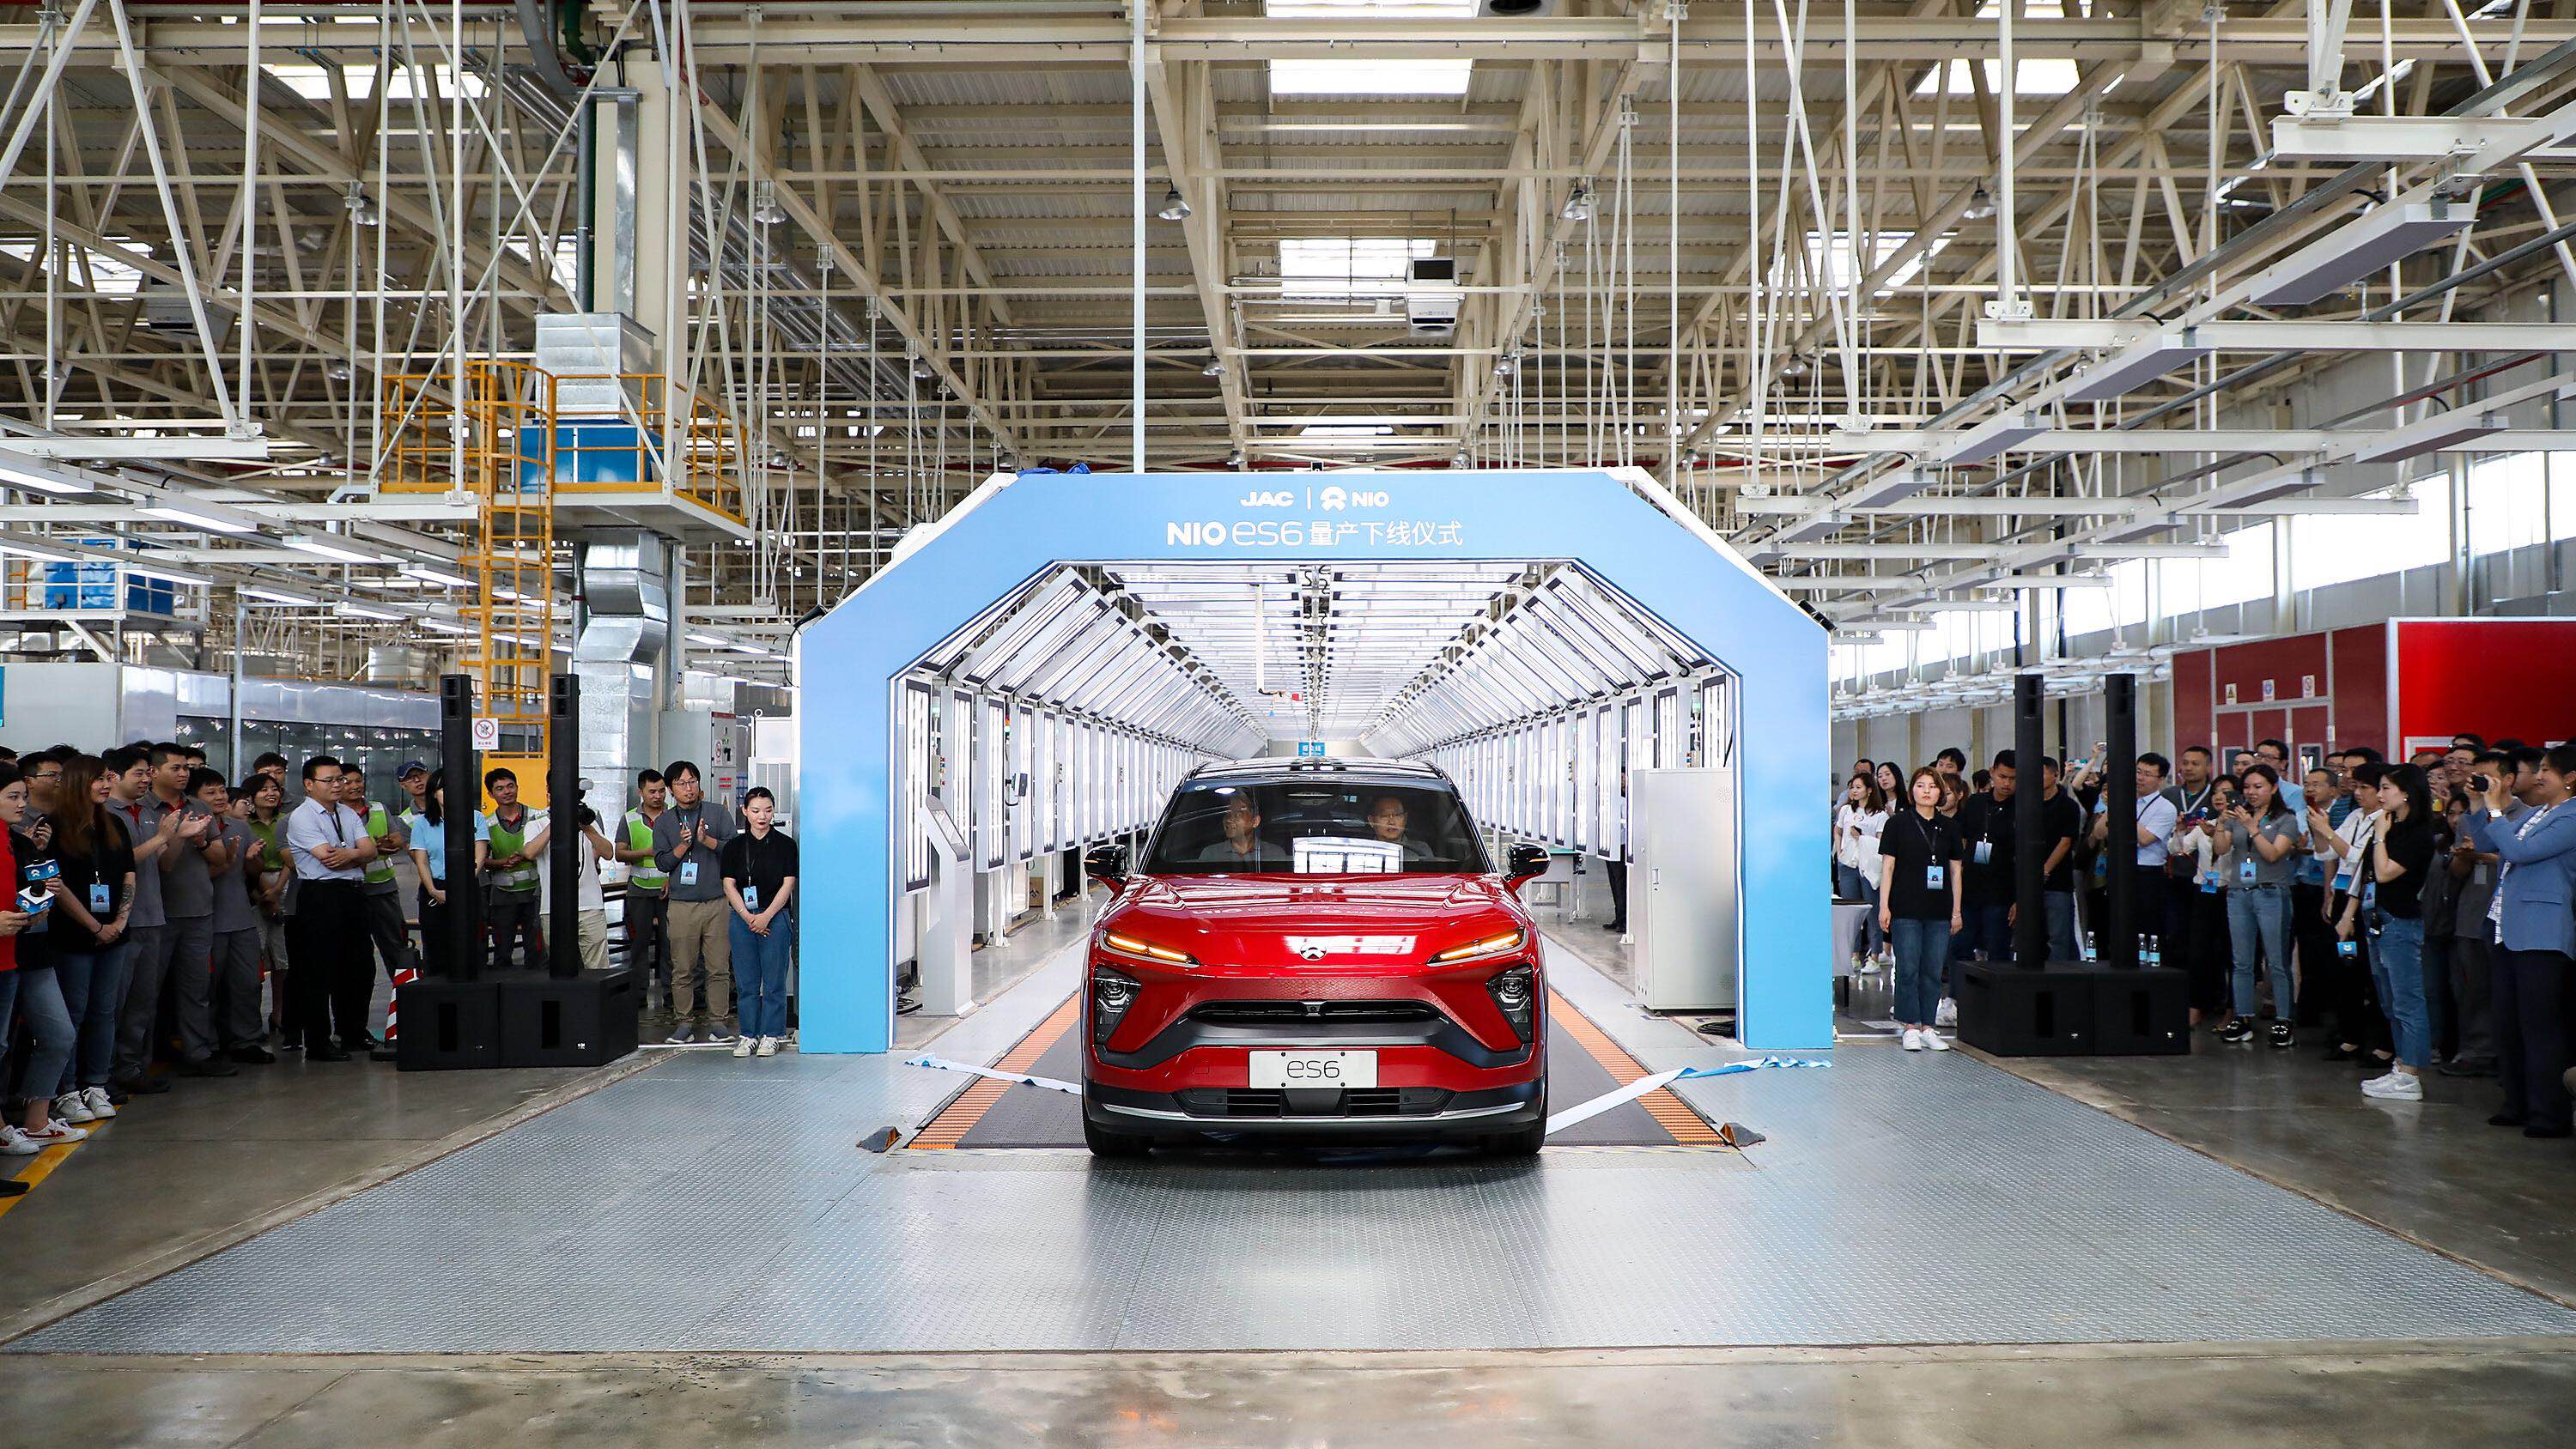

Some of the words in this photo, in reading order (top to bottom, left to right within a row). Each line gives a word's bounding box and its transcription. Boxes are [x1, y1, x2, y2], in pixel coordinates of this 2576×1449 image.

[1240, 491, 1294, 506] JAC
[1352, 491, 1389, 507] NIO
[1167, 521, 1227, 547] NIO
[1309, 520, 1463, 546] 量产下线仪式
